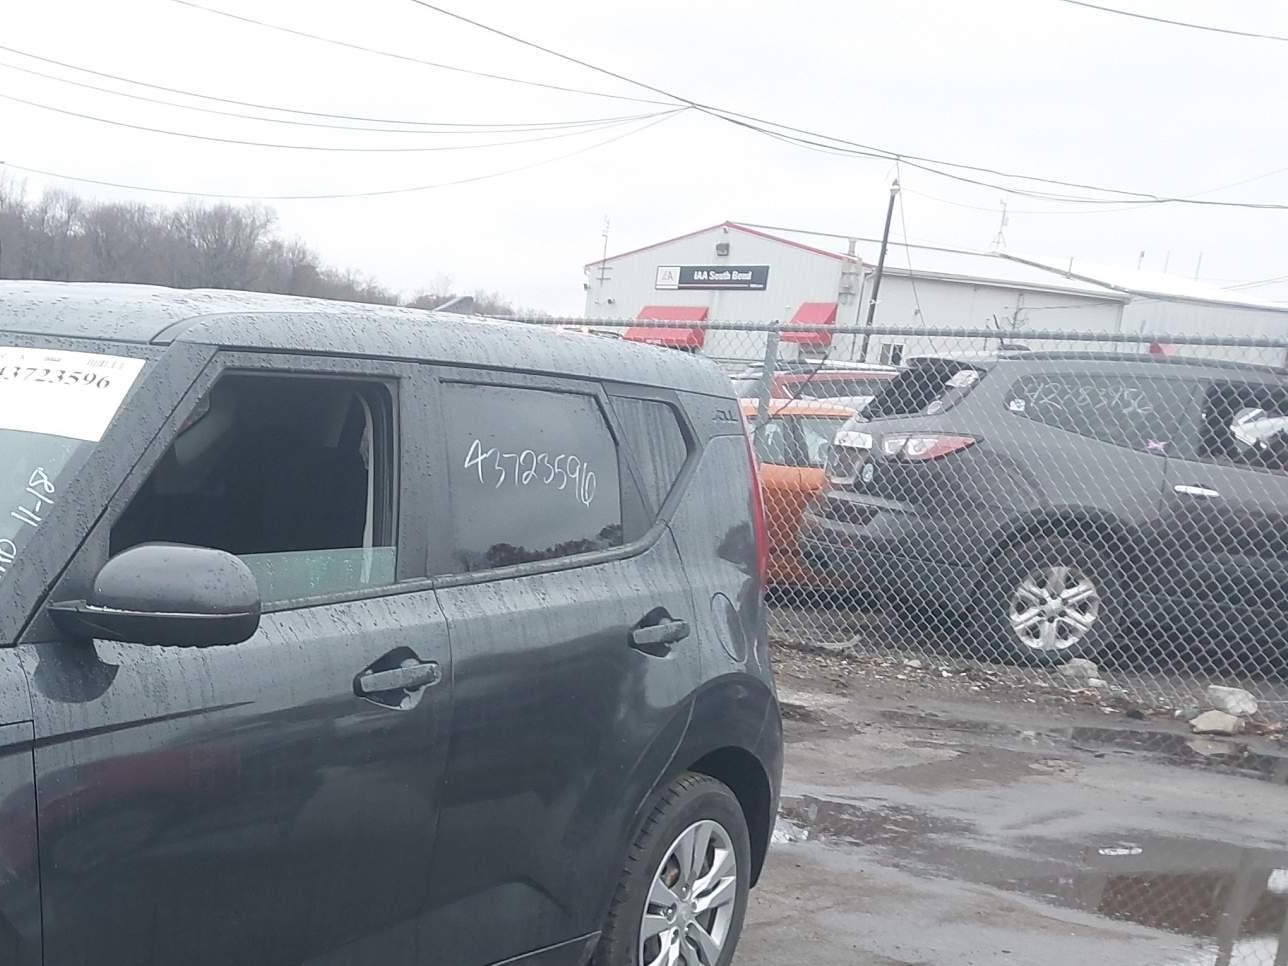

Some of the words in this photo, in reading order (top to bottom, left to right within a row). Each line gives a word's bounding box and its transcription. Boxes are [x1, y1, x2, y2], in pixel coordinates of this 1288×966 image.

[693, 270, 708, 280] IAA
[709, 270, 731, 280] South
[732, 270, 752, 280] Bend
[10, 466, 56, 527] 11-18
[463, 438, 597, 508] 43723596
